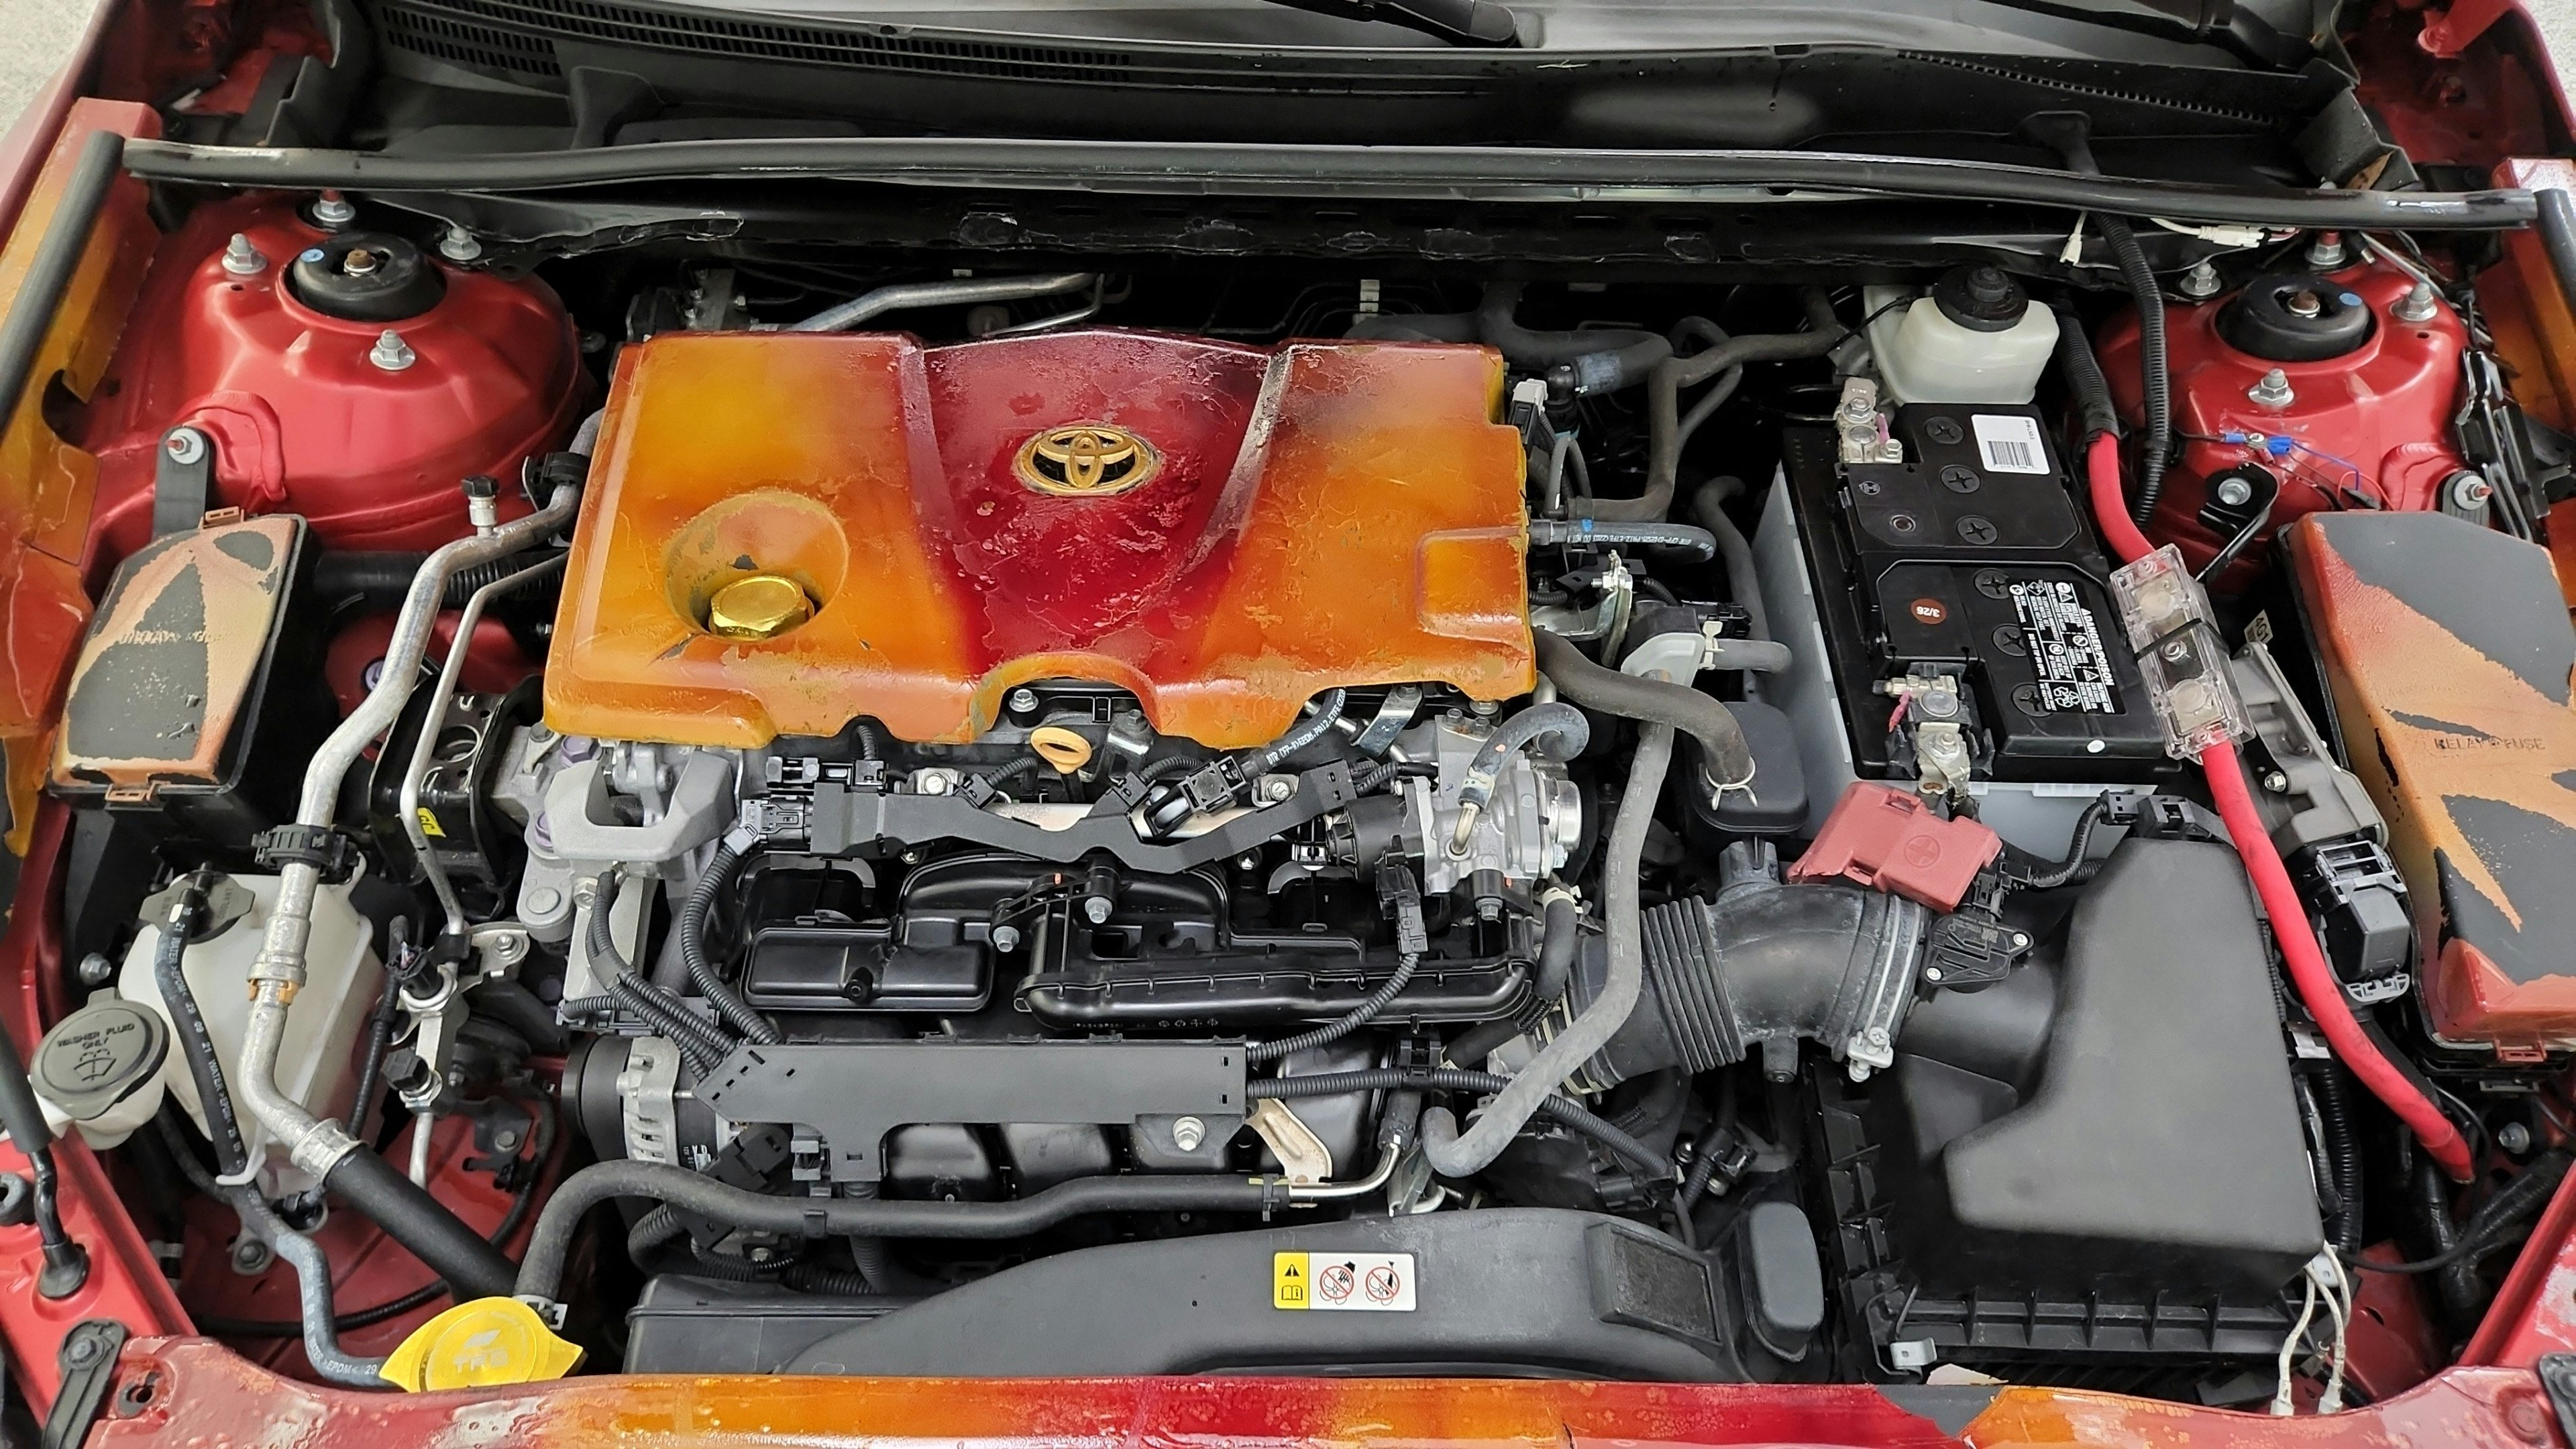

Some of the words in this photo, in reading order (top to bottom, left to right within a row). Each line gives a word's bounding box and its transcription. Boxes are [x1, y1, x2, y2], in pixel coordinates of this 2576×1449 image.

[1917, 606, 1940, 617] 3/26
[2084, 615, 2114, 685] DANGER/POISON
[2504, 738, 2546, 750] FUSE
[57, 1031, 101, 1048] WASHER
[106, 1022, 136, 1036] FLUID
[82, 1037, 109, 1051] ONLY
[207, 1059, 224, 1092] WATER
[307, 1334, 324, 1366] WATER
[365, 1364, 378, 1376] 29
[453, 1347, 509, 1373] TRD
